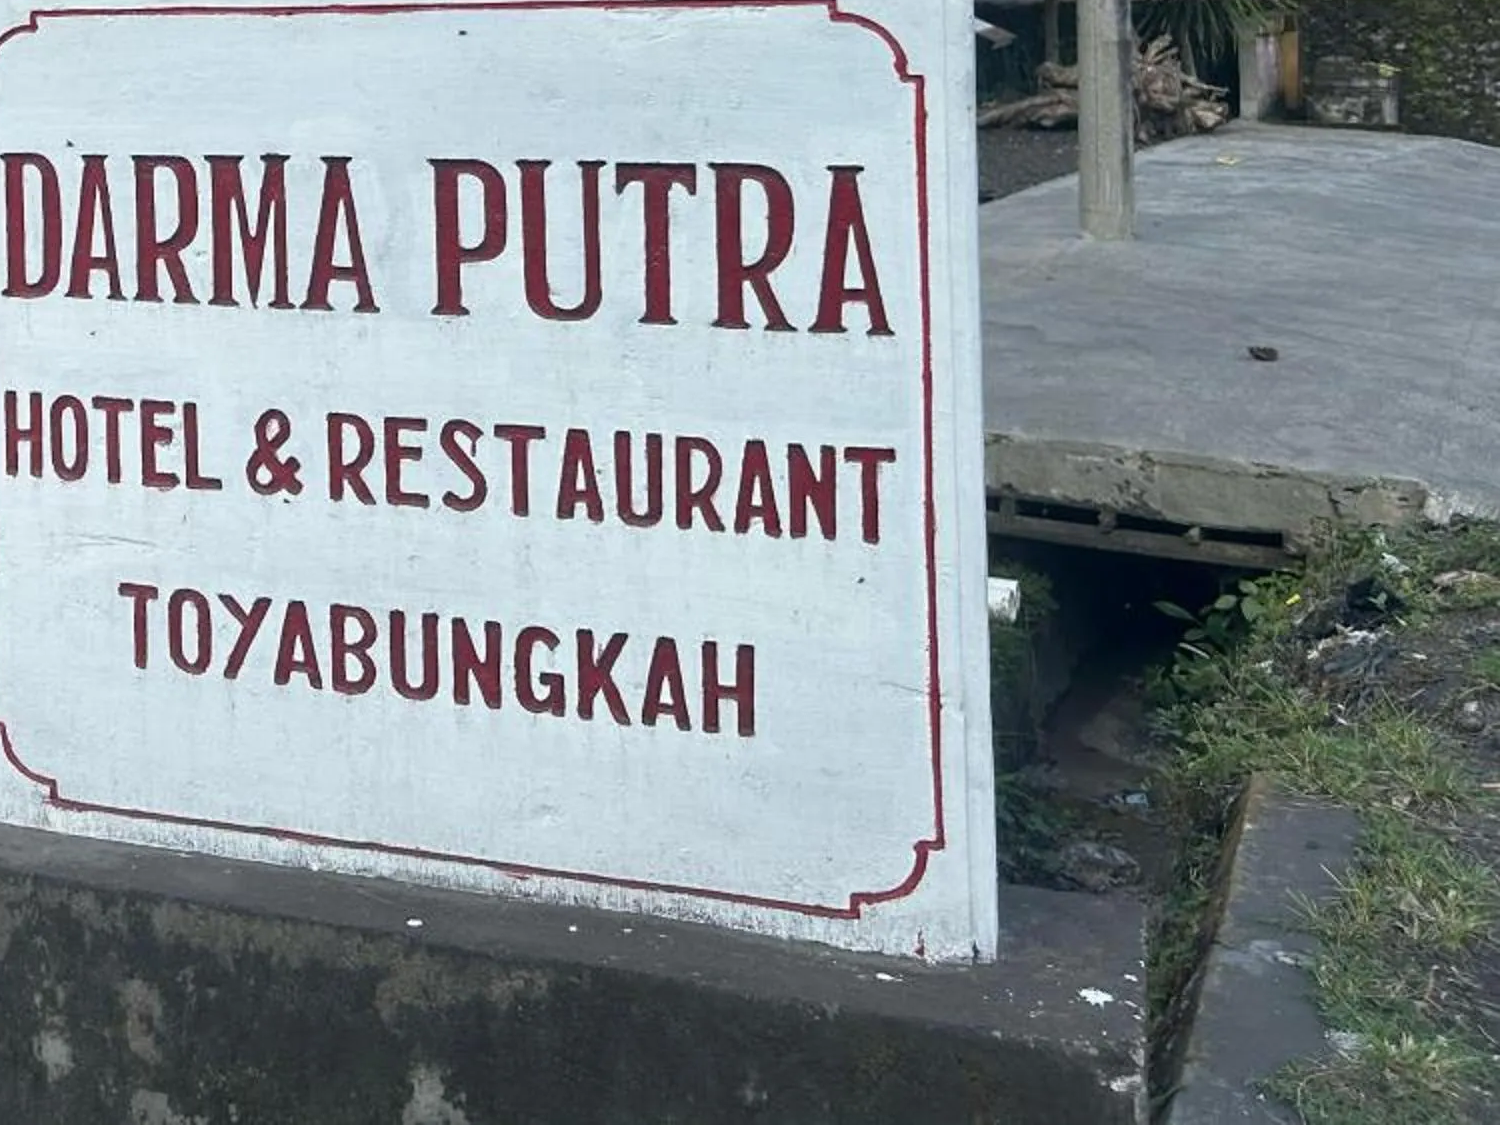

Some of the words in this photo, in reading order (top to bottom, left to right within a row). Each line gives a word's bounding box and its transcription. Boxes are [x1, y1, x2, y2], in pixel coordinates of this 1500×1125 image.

[0, 152, 380, 313] DARMA
[429, 157, 895, 336] PUTRA
[4, 390, 222, 491] HOTEL
[245, 408, 301, 495] &
[326, 412, 897, 545] RESTAURANT
[117, 581, 756, 737] TOYABUNGKAH
